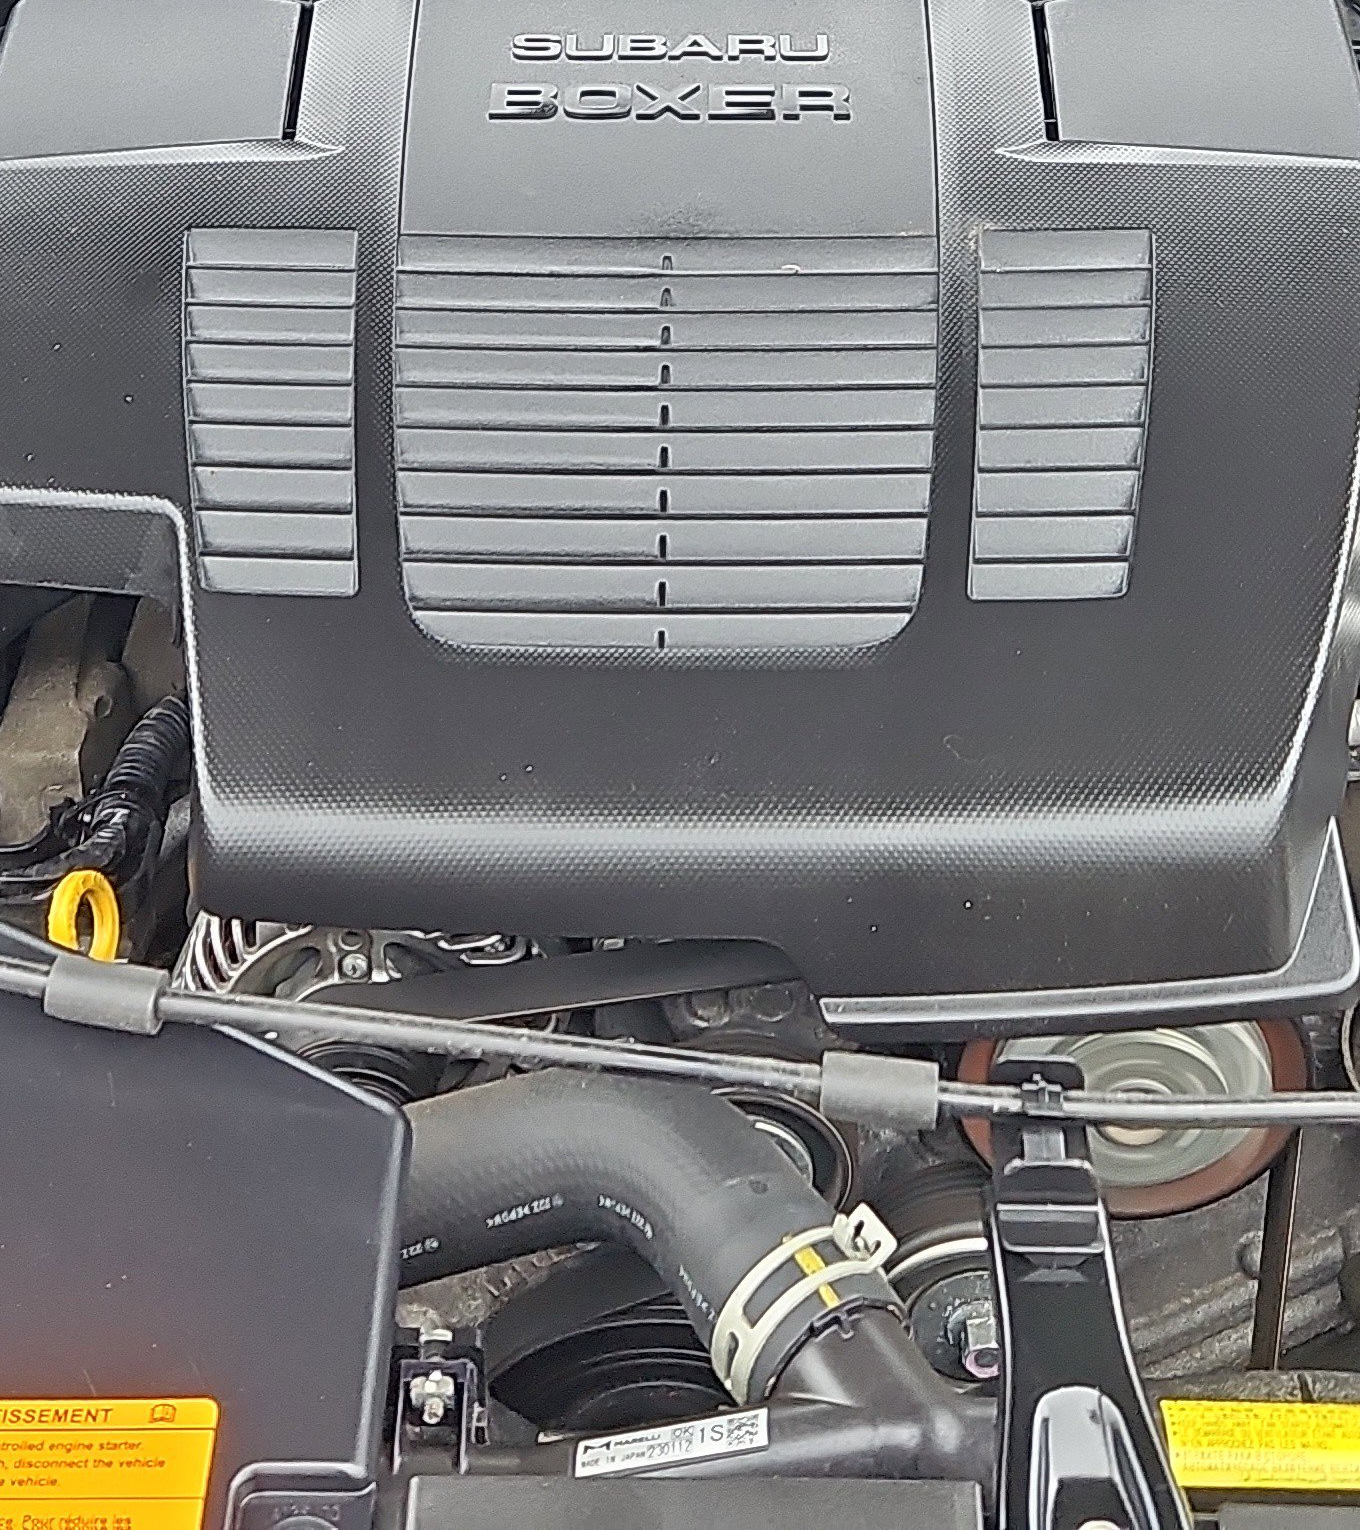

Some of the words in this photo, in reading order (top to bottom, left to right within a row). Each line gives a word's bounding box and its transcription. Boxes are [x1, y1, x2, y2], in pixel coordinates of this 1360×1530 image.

[511, 34, 830, 61] SUBARU
[487, 83, 851, 120] BOXER
[672, 1425, 693, 1438] OK
[48, 1440, 94, 1455] engine
[647, 1438, 690, 1458] 230112
[13, 1457, 89, 1469] disconnect
[92, 1457, 115, 1469] the
[119, 1457, 166, 1469] vehicle
